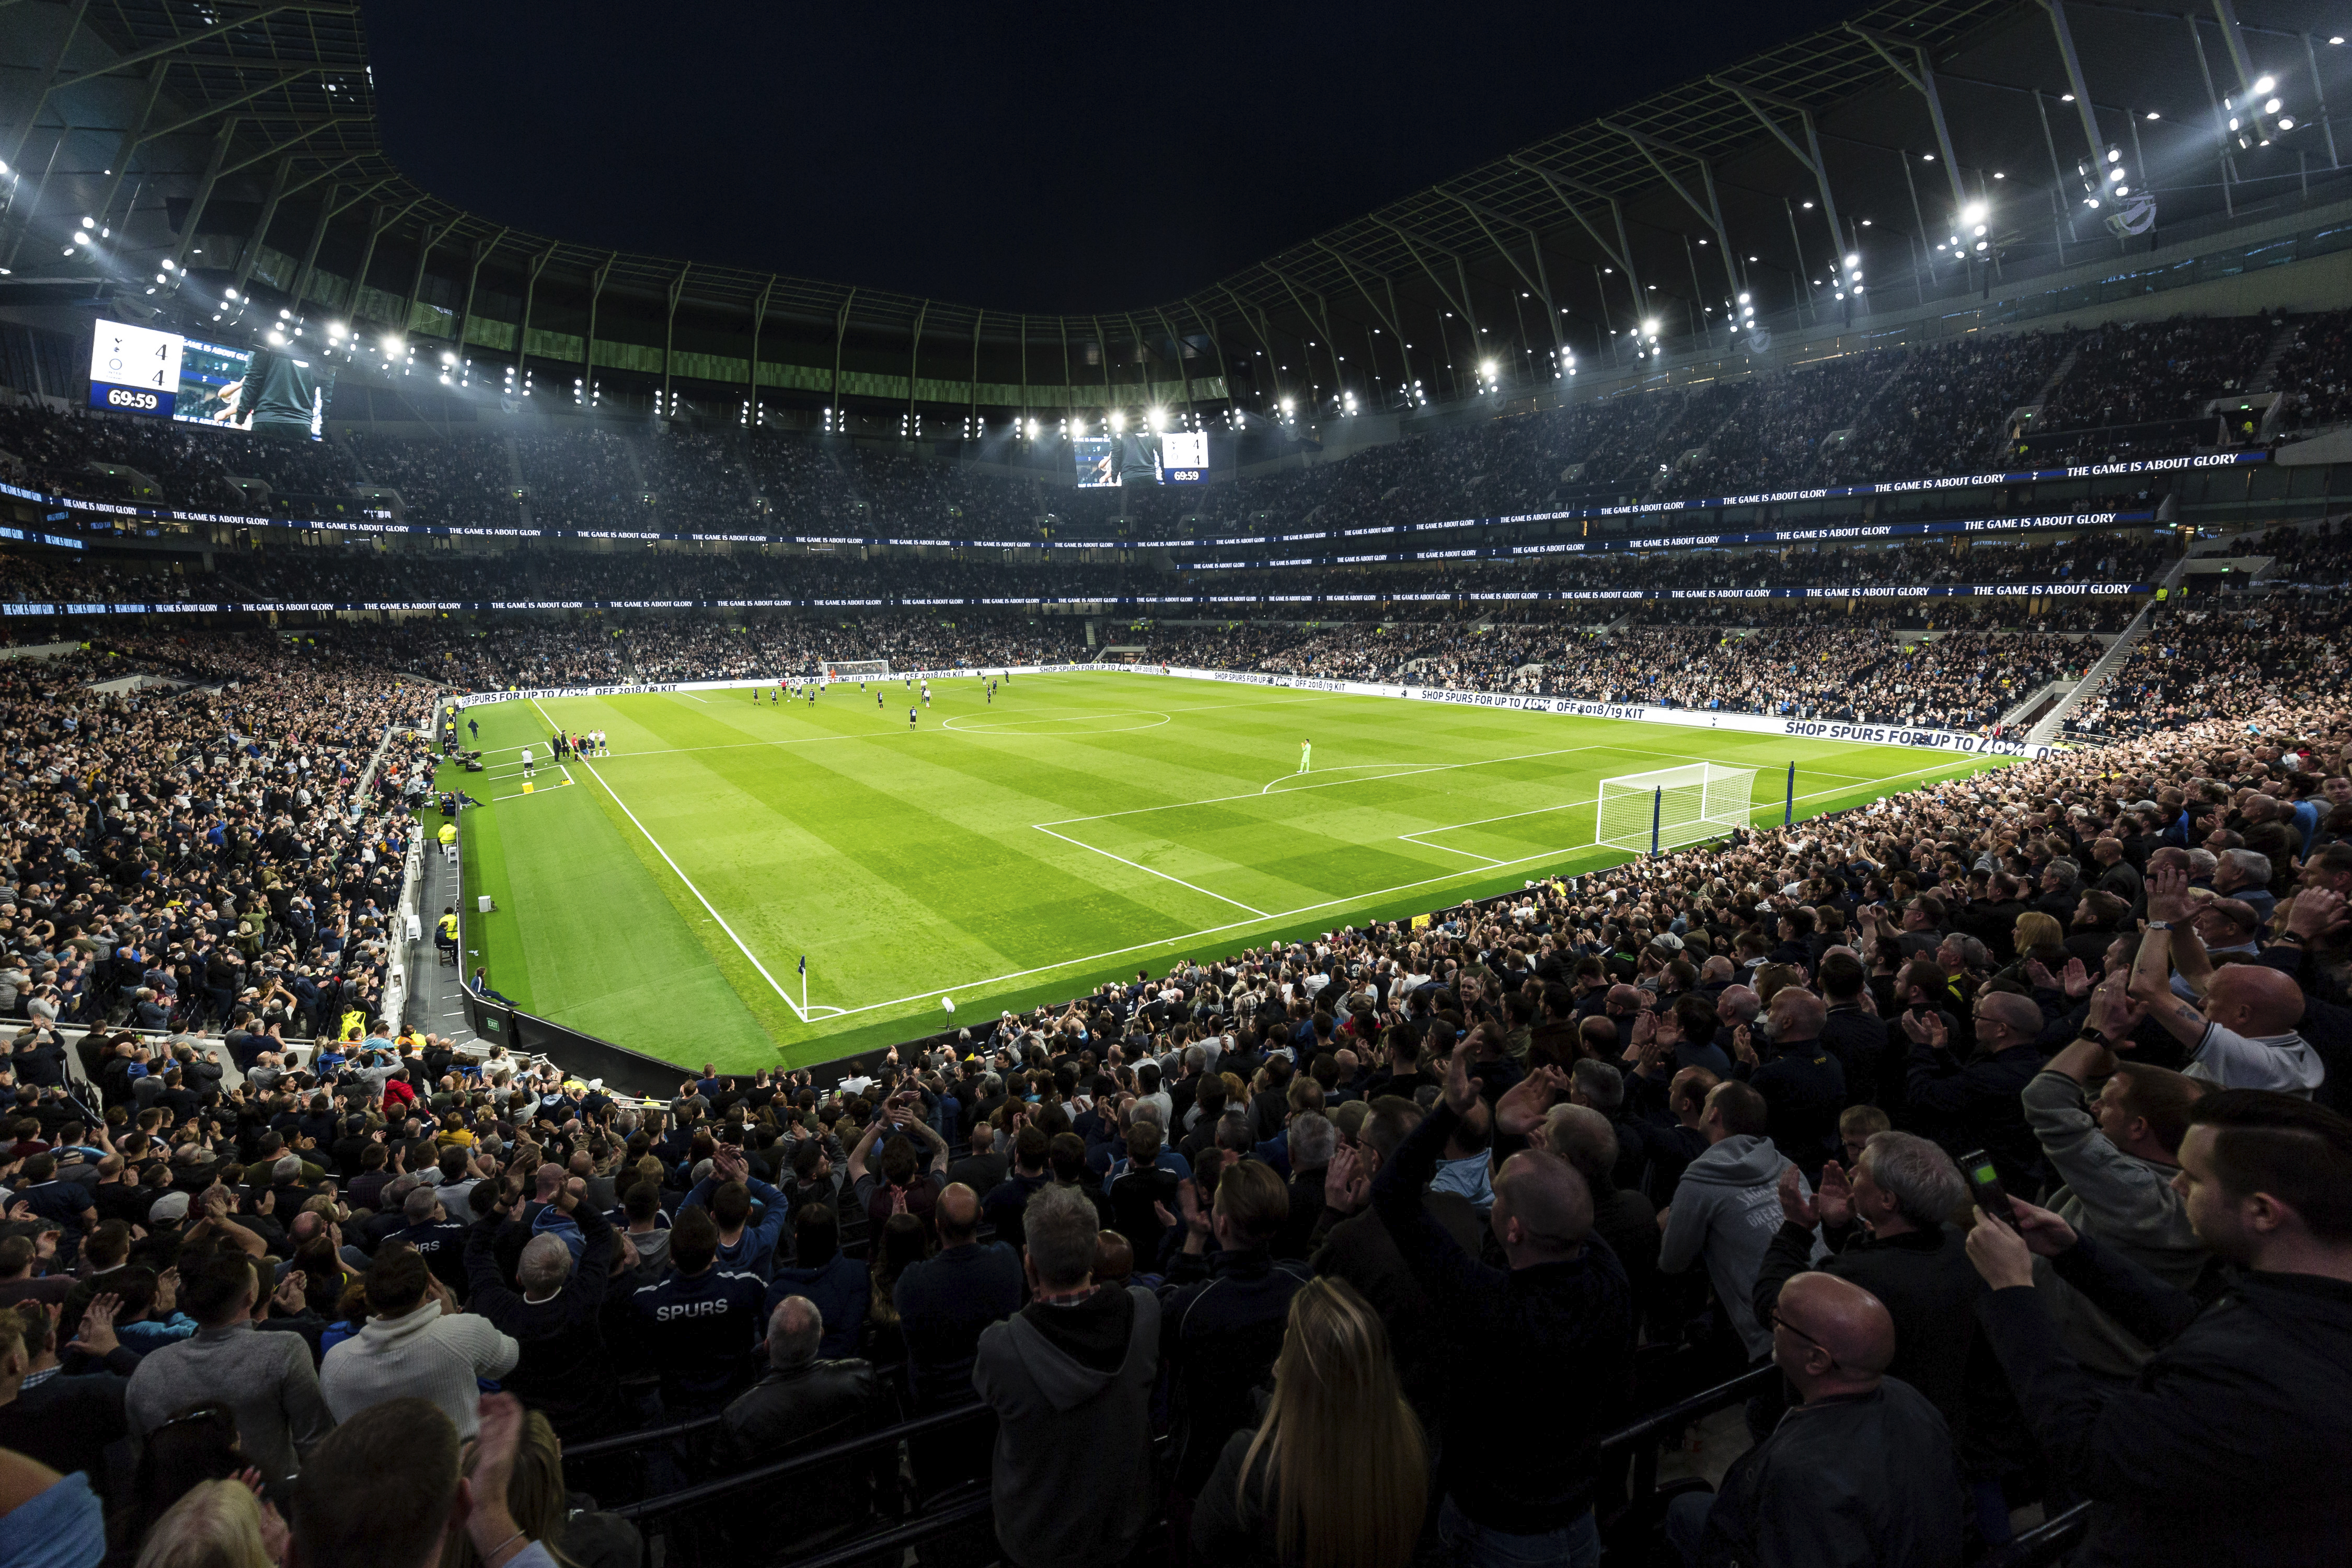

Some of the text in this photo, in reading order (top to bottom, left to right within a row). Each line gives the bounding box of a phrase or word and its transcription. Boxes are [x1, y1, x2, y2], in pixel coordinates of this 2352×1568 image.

[155, 344, 168, 360] 4
[152, 370, 165, 386] 4
[109, 389, 157, 409] 69:59
[1193, 440, 1199, 449] 4
[1194, 455, 1200, 465] 4
[2067, 454, 2238, 476] THE GAME IS ABOUT GLORY
[1174, 471, 1199, 480] 69:59
[1875, 474, 2005, 492] THE GAME IS ABOUT GLORY
[1964, 513, 2116, 529] THE GAME IS ABOUT GLORY
[1793, 530, 1817, 538] GAME
[1829, 528, 1860, 536] ABOUT
[1861, 526, 1891, 535] GLORY
[1862, 587, 1895, 596] ABOUT
[1897, 587, 1929, 595] GLORY
[1973, 584, 2131, 595] THE GAME IS ABOUT GLORY
[1143, 666, 1159, 675] 2018/19
[1229, 673, 1246, 682] SPURS
[1247, 675, 1258, 683] FOR
[1259, 675, 1266, 684] UP
[1308, 681, 1333, 691] 2018/19
[1334, 683, 1346, 691] KIT
[472, 694, 496, 704] SPURS
[500, 692, 520, 701] FOR
[1422, 690, 1444, 700] SHOP
[1445, 693, 1473, 703] SPURS
[1474, 695, 1493, 705] FOR
[1494, 697, 1507, 706] UP
[1509, 698, 1520, 707] TO
[1525, 699, 1550, 709] 40%
[1557, 702, 1577, 712] OFF
[1625, 708, 1645, 719] KIT
[1785, 722, 1827, 736] SHOP
[1830, 725, 1884, 742] SPURS
[1929, 734, 1951, 747] UP
[1955, 736, 1974, 751] TO
[1981, 739, 2025, 756] 40%
[488, 1020, 498, 1029] EXIT
[656, 1299, 728, 1321] SPURS
